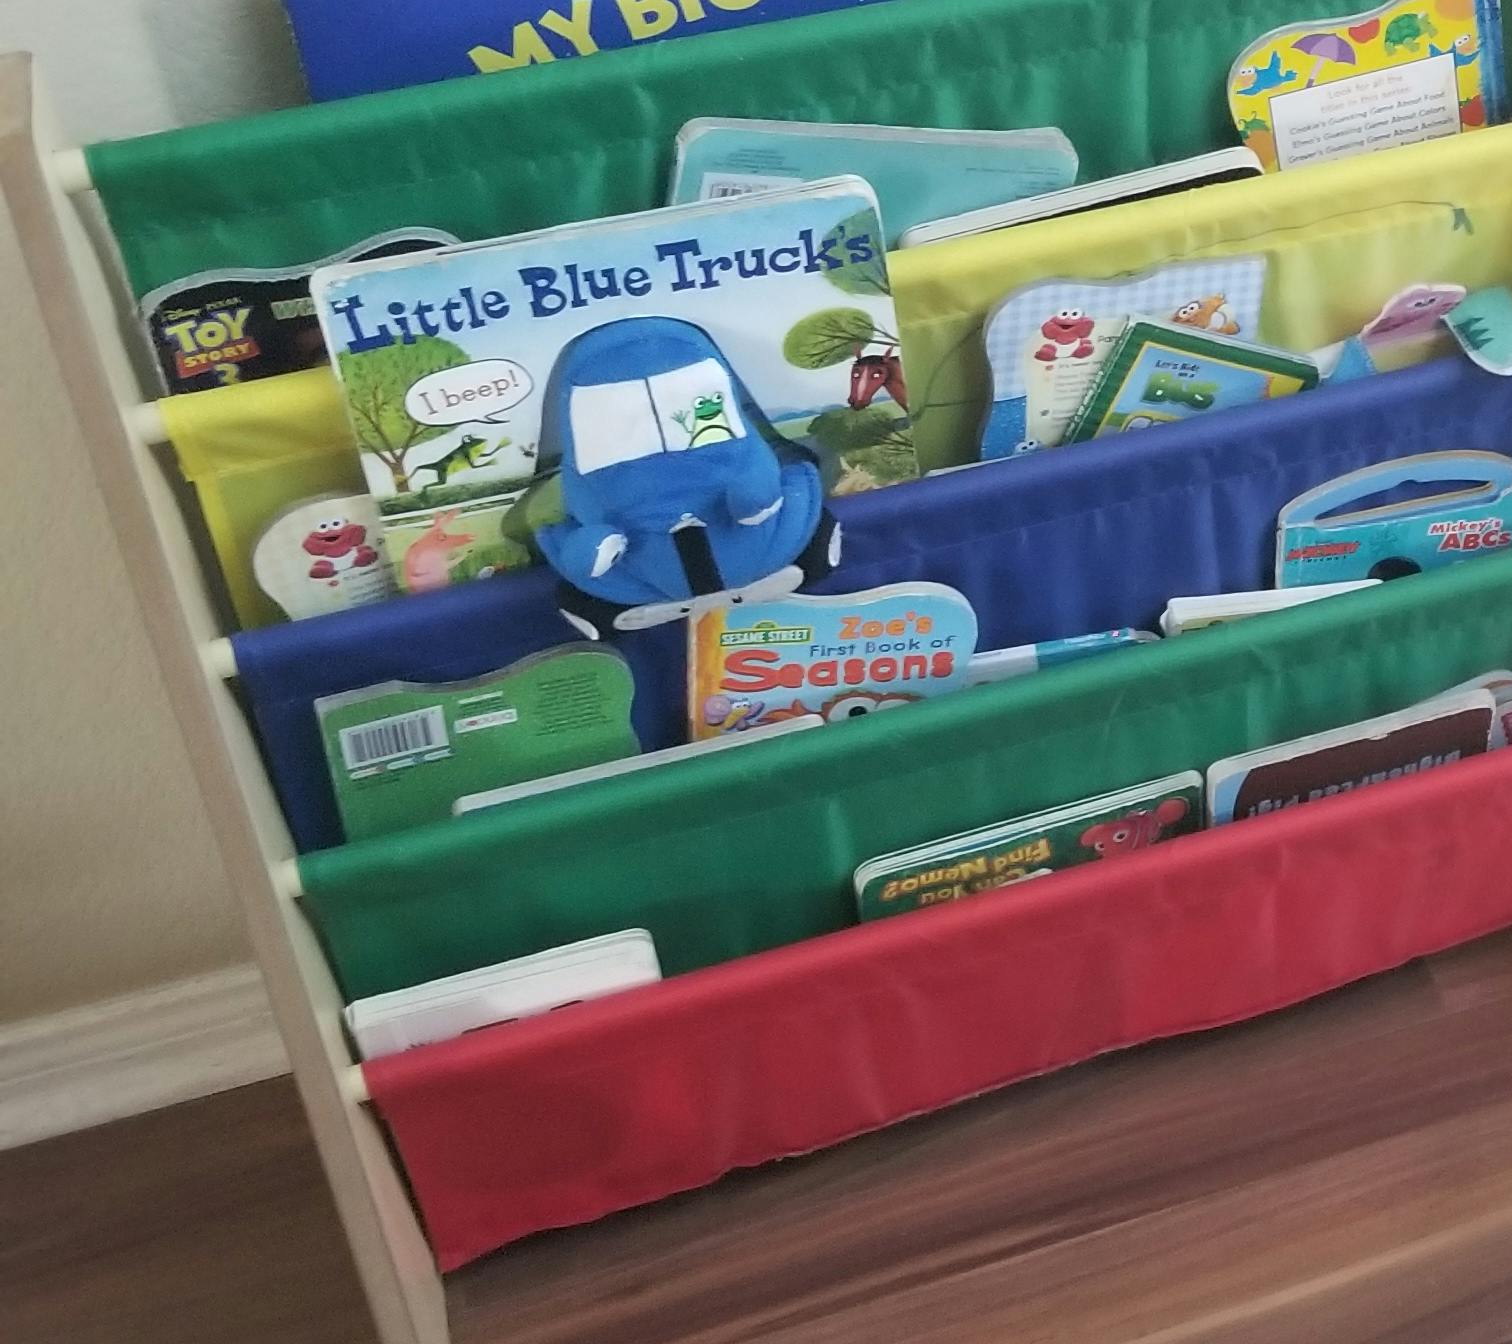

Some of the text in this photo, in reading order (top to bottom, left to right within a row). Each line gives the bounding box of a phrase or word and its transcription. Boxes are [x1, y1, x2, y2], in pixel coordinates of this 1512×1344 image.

[330, 225, 874, 354] Little Blue Truck's
[164, 308, 251, 354] TOY
[184, 342, 250, 368] STORY
[419, 369, 520, 416] I beep!
[1429, 518, 1503, 535] Mickey's
[1438, 530, 1512, 551] ABCs
[721, 628, 810, 646] SESAME STREET
[839, 610, 934, 640] Zoe's
[809, 635, 958, 657] First Book of
[720, 649, 955, 692] Seasons
[881, 837, 1051, 901] Find Nemo?
